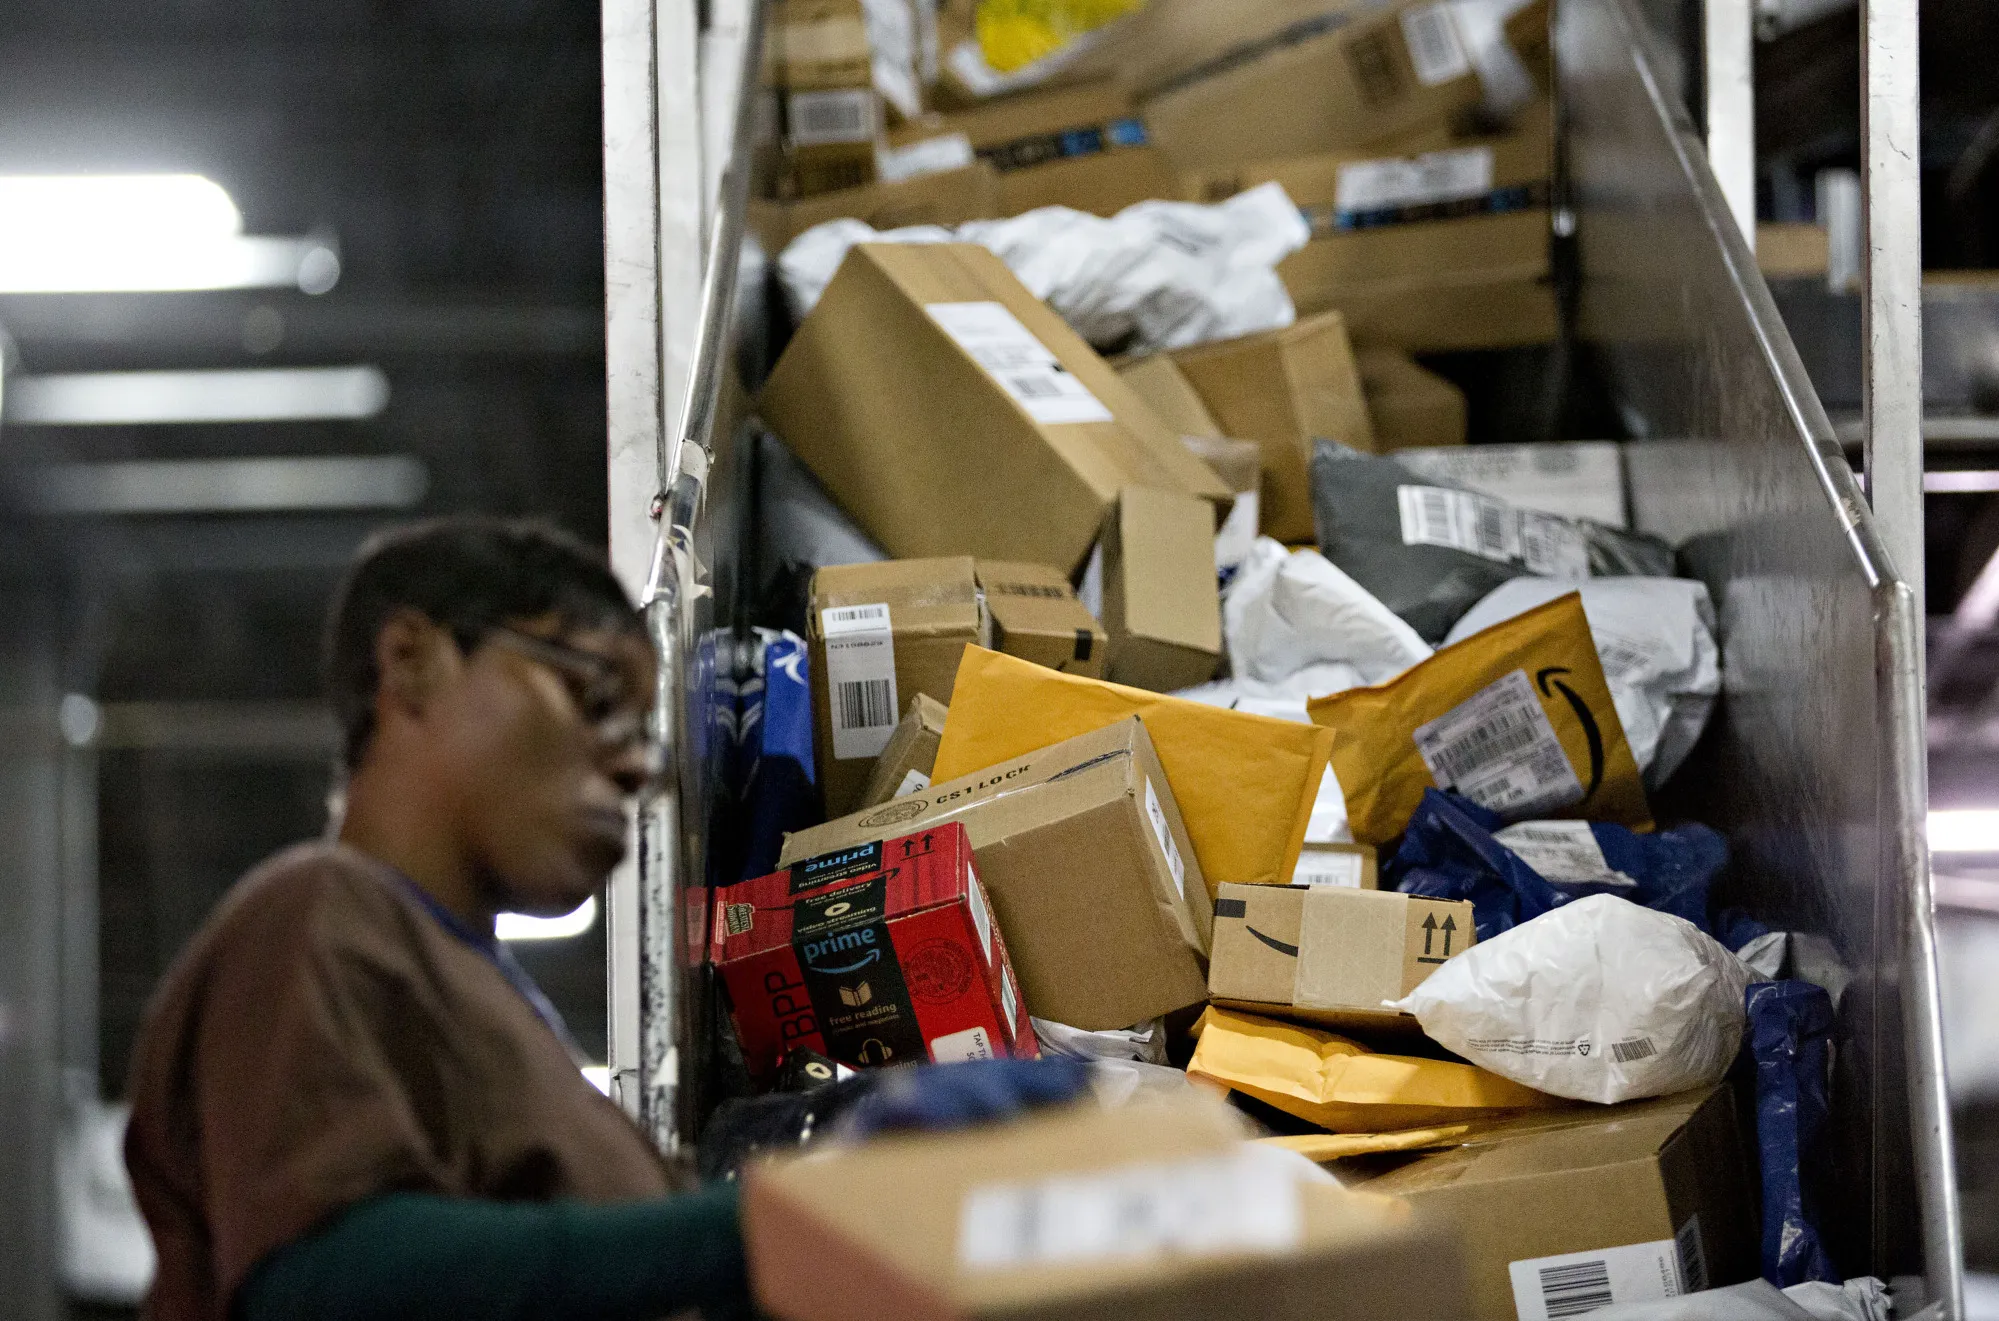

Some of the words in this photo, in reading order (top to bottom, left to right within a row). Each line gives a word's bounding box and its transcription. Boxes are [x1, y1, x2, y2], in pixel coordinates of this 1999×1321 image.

[804, 844, 874, 873] prime
[850, 863, 877, 874] video
[798, 871, 848, 888] streaming
[805, 894, 827, 904] free
[829, 882, 872, 897] delivery
[797, 922, 825, 933] video
[826, 906, 877, 924] streaming
[804, 928, 876, 963] prime
[829, 1014, 852, 1026] free
[855, 1003, 897, 1020] reading
[973, 1032, 983, 1047] TAP
